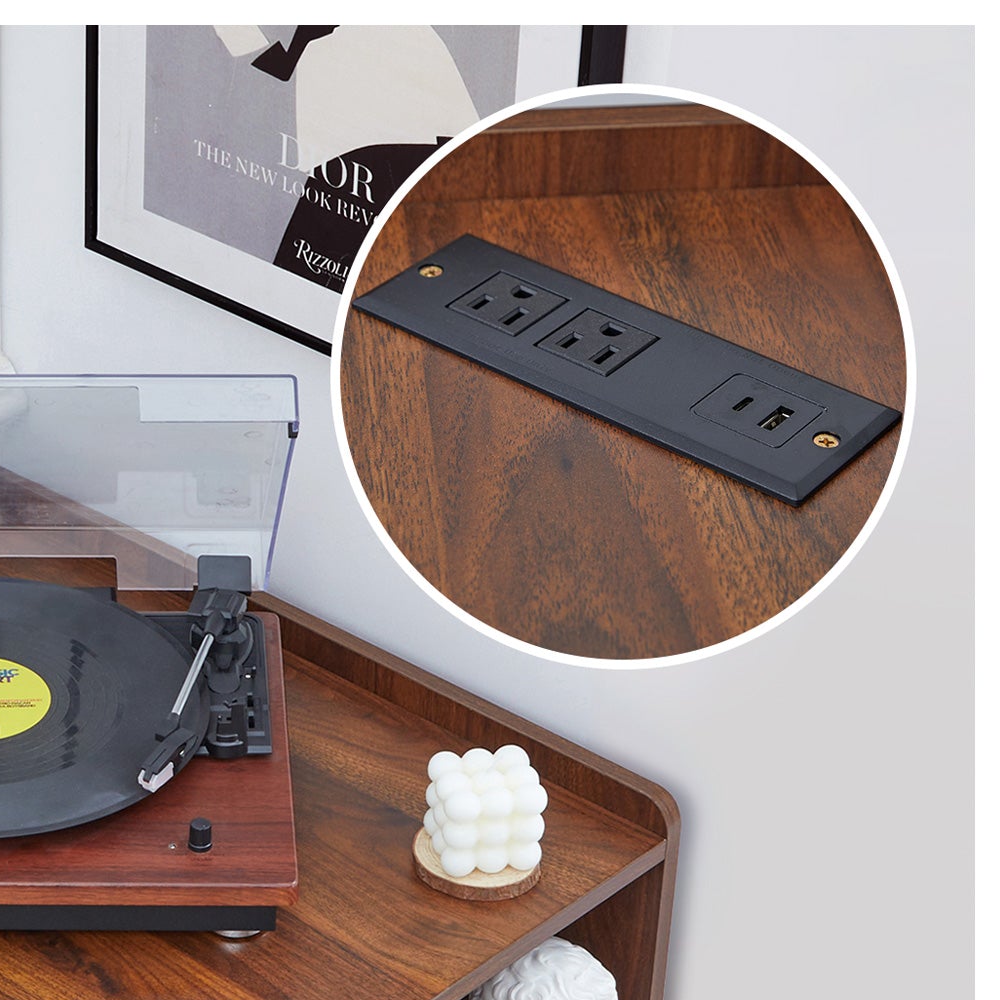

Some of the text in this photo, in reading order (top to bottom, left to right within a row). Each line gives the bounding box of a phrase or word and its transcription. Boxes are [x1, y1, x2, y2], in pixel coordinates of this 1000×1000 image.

[193, 138, 232, 169] THE
[235, 156, 278, 187] NEW
[282, 175, 333, 212] LOOK
[293, 238, 350, 278] RIZZOLI
